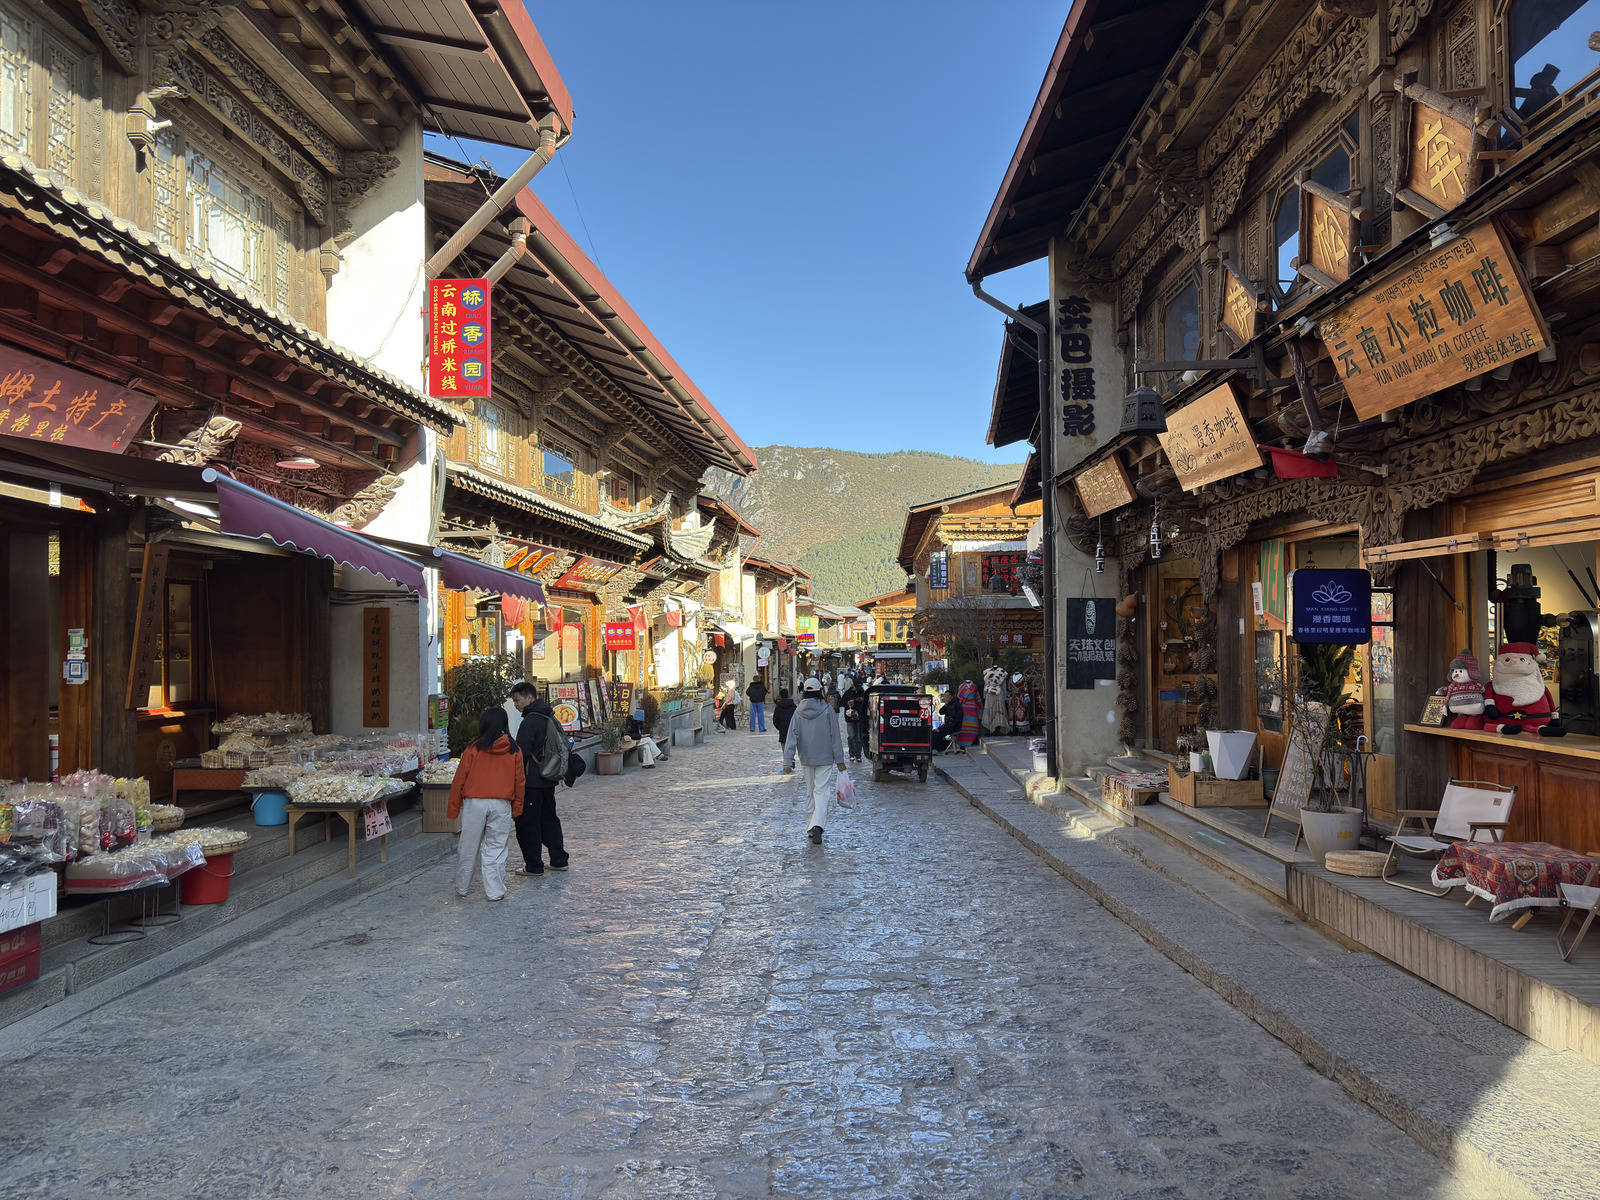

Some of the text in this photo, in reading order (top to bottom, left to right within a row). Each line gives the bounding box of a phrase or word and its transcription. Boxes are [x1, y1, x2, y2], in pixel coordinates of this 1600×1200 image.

[1313, 206, 1350, 274] 松
[440, 284, 458, 391] 云南过桥米线
[1335, 255, 1510, 379] 云南小粒咖啡
[1373, 371, 1394, 387] YUN
[1392, 364, 1413, 380] NAN
[1452, 323, 1490, 352] COFFEE
[1461, 327, 1536, 373] 现烘焙体验店
[1191, 407, 1239, 449] 漫香咖啡
[1312, 614, 1351, 624] 漫香咖啡
[1069, 638, 1116, 651] 天珠文创
[920, 710, 929, 718] 29
